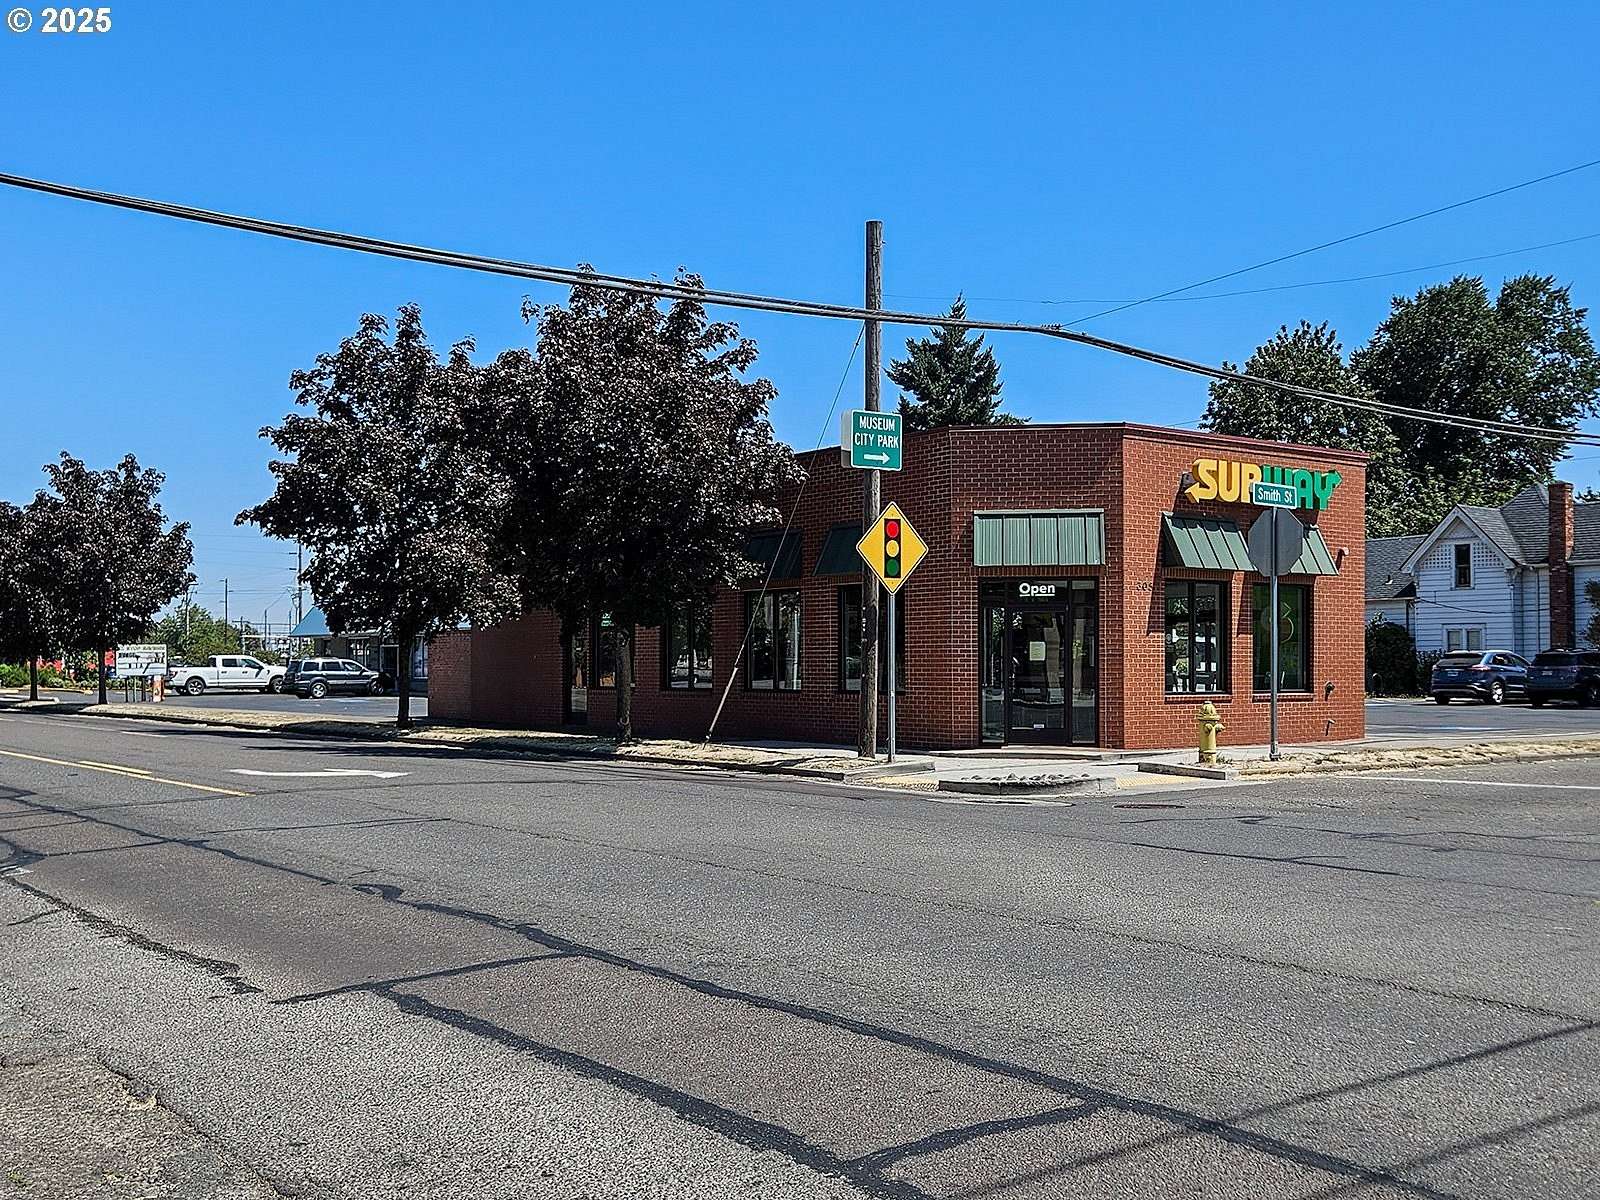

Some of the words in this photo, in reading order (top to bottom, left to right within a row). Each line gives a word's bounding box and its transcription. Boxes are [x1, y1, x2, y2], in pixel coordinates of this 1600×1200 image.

[859, 415, 896, 431] MUSEUM
[854, 432, 875, 447] CITY
[877, 434, 899, 449] PARK
[1257, 486, 1281, 502] Smith
[1284, 490, 1293, 504] St
[1019, 582, 1056, 597] Open
